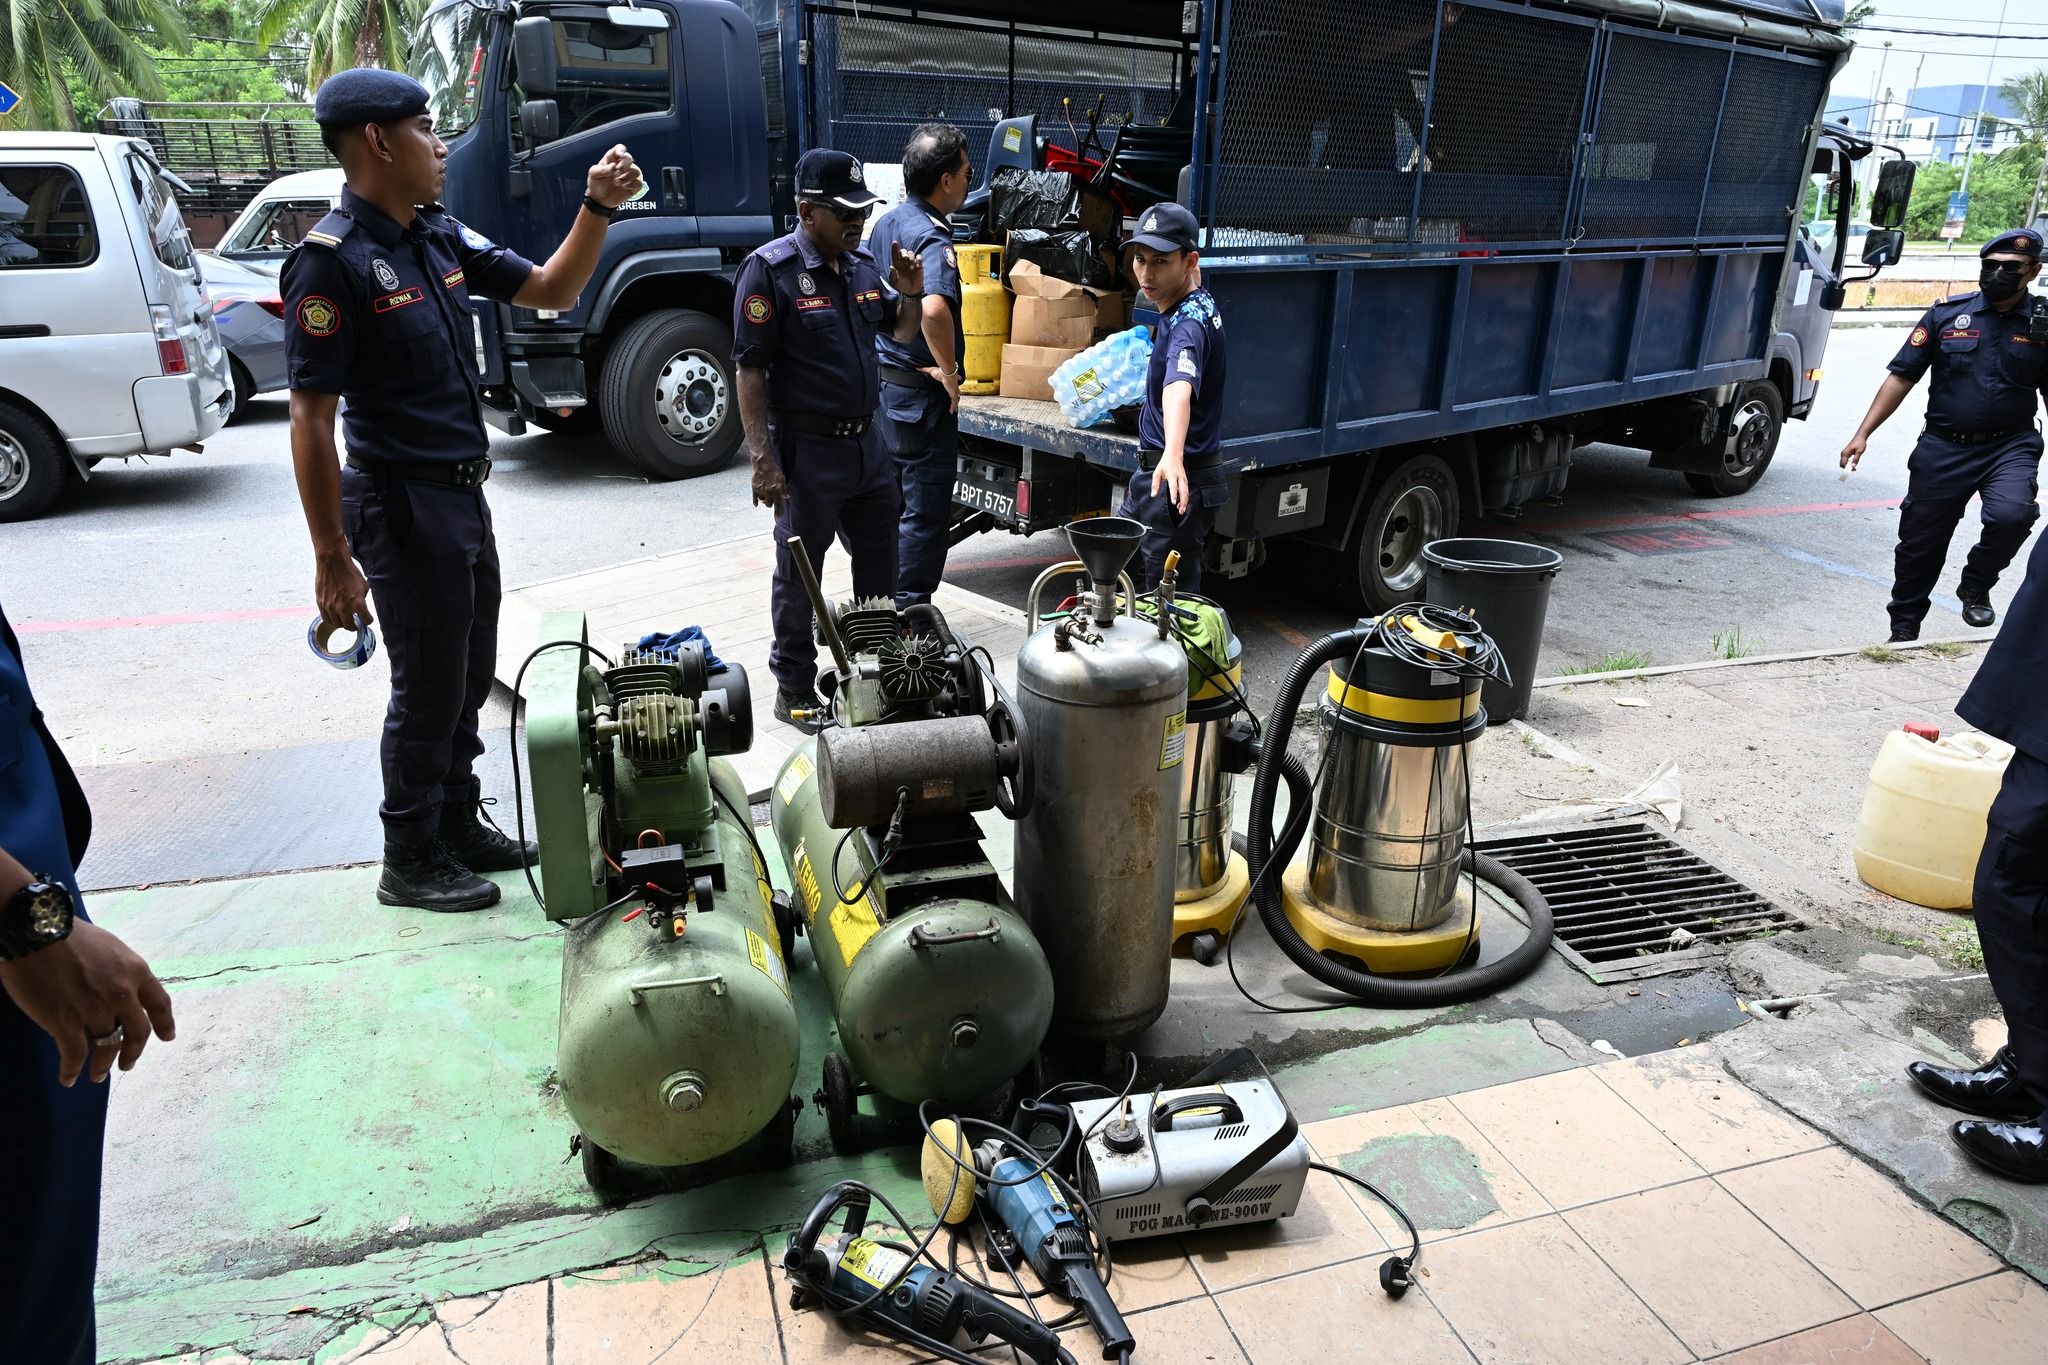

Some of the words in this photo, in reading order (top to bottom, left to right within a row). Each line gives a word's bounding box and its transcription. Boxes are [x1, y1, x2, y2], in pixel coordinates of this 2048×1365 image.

[389, 293, 412, 306] RIZWAN
[960, 482, 983, 506] BPT
[984, 490, 1014, 516] 5757
[1129, 1217, 1158, 1233] FOG
